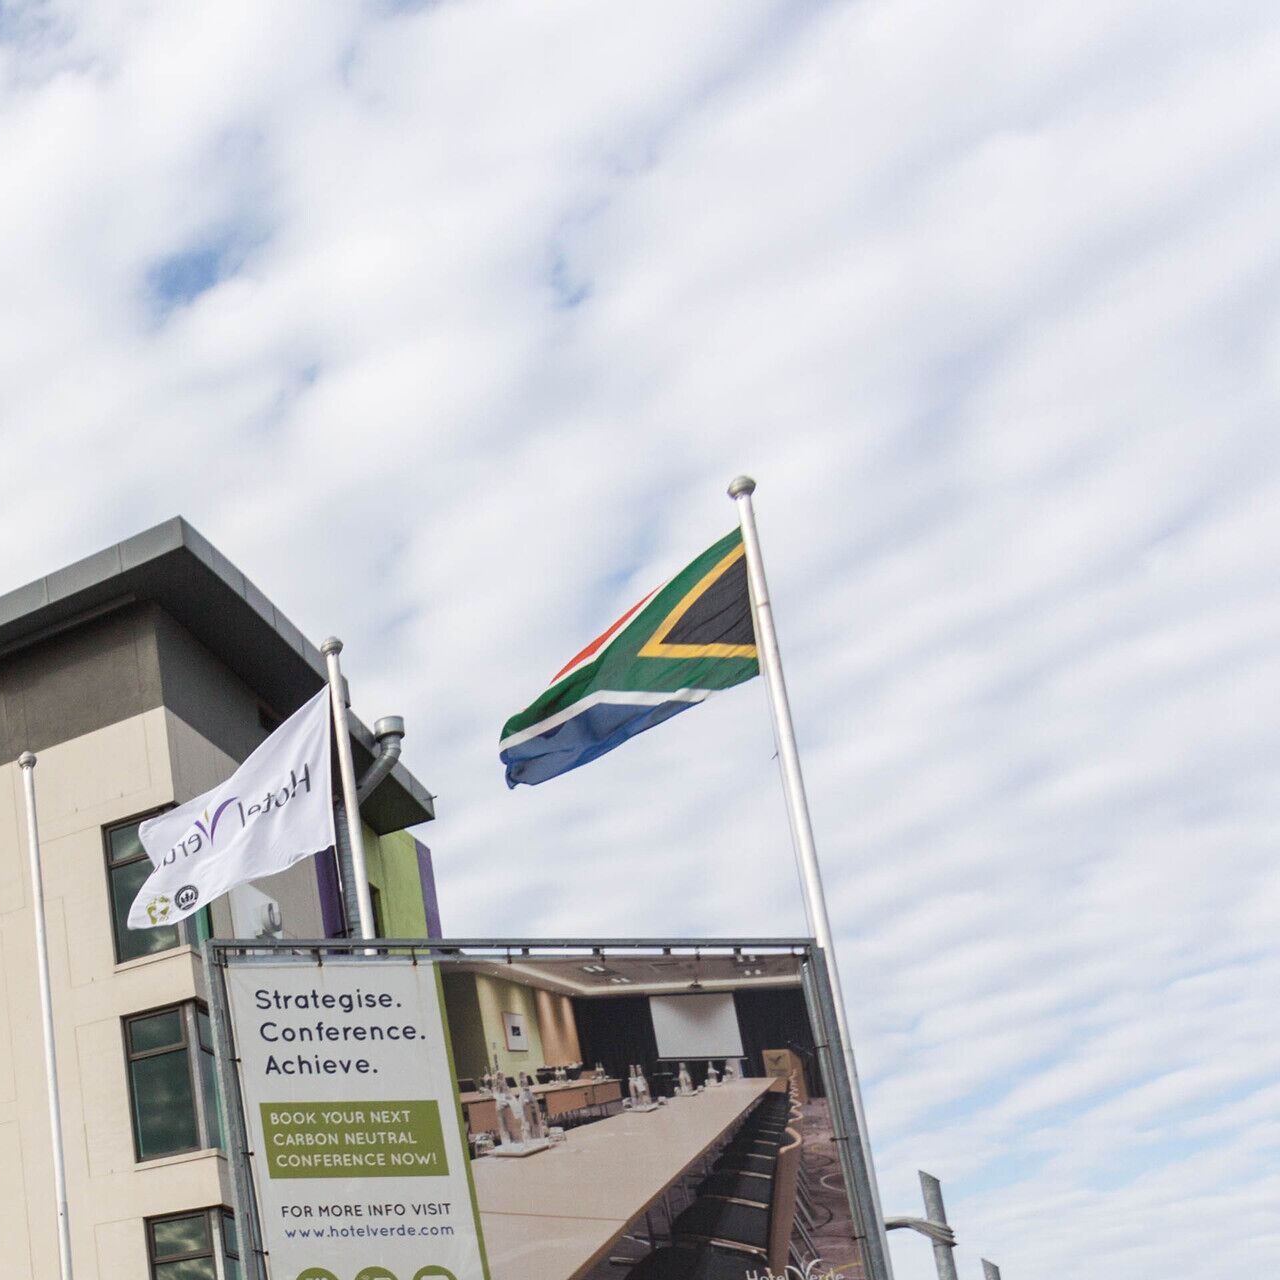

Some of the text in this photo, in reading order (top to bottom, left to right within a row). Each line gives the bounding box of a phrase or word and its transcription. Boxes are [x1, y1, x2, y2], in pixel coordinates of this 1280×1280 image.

[255, 989, 402, 1012] Strategise.
[260, 1022, 426, 1042] Conference.
[265, 1055, 378, 1075] Achieve.
[270, 1110, 411, 1125] BOOK YOUR NEXT
[273, 1131, 417, 1146] CARBON NEUTRAL
[276, 1152, 438, 1167] CONFERENCE NOW!
[281, 1203, 451, 1217] FOR MORE INFO VISIT
[285, 1225, 454, 1238] www.hotelverde.com
